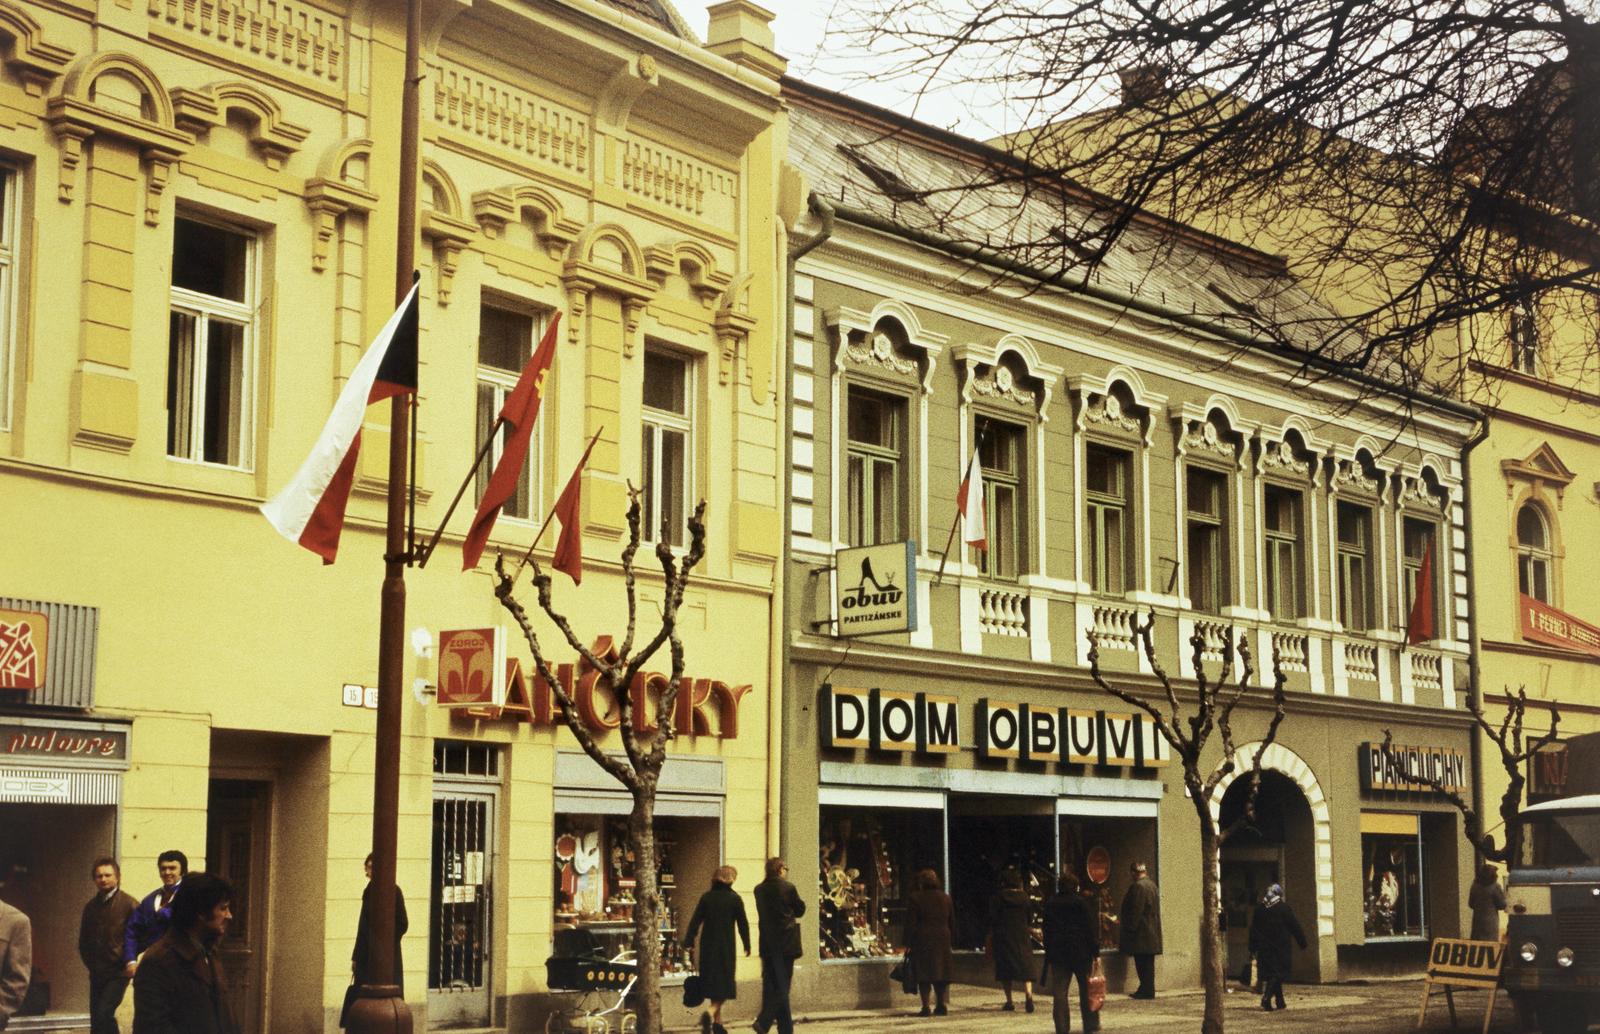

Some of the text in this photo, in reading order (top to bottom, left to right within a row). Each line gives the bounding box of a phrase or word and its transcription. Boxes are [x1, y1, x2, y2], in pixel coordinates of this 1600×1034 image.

[841, 587, 904, 609] obuv
[843, 610, 902, 624] PARTIZÁNSKE
[449, 635, 753, 739] AHÔDKY
[834, 693, 1161, 761] DOM OBUVI
[1432, 942, 1501, 970] OBUV
